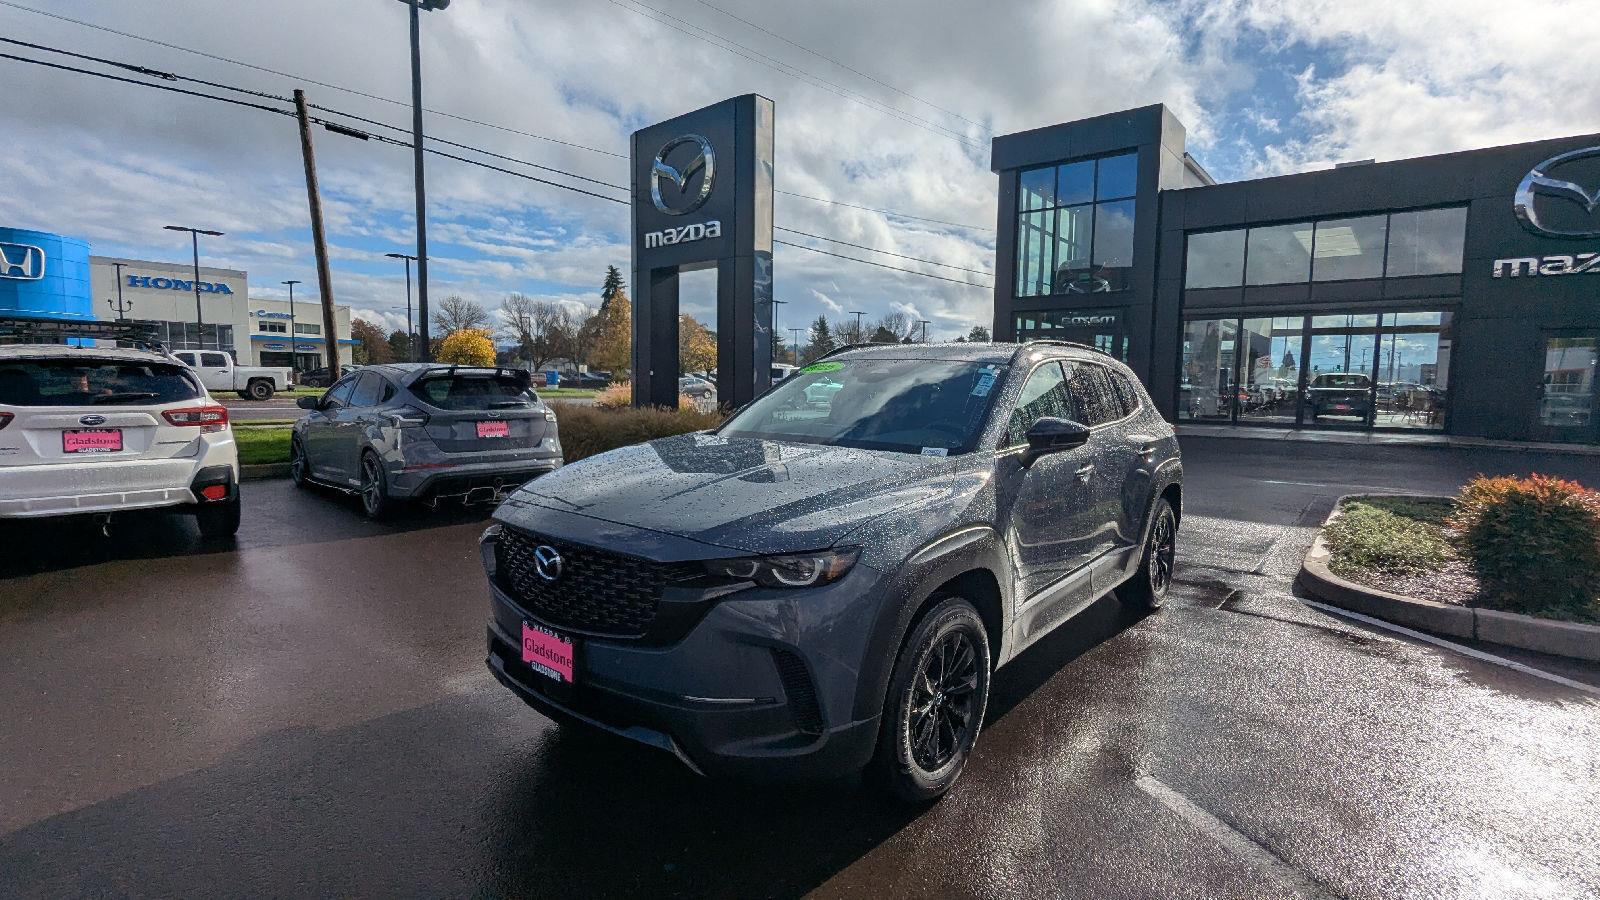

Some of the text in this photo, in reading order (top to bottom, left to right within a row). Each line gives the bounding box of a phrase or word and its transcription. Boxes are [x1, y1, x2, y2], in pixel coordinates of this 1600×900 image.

[645, 220, 722, 249] mazda
[127, 274, 234, 295] HONDA
[66, 437, 120, 445] Gladstone
[524, 637, 573, 668] Gladstone
[531, 661, 561, 682] GLADSTONE
